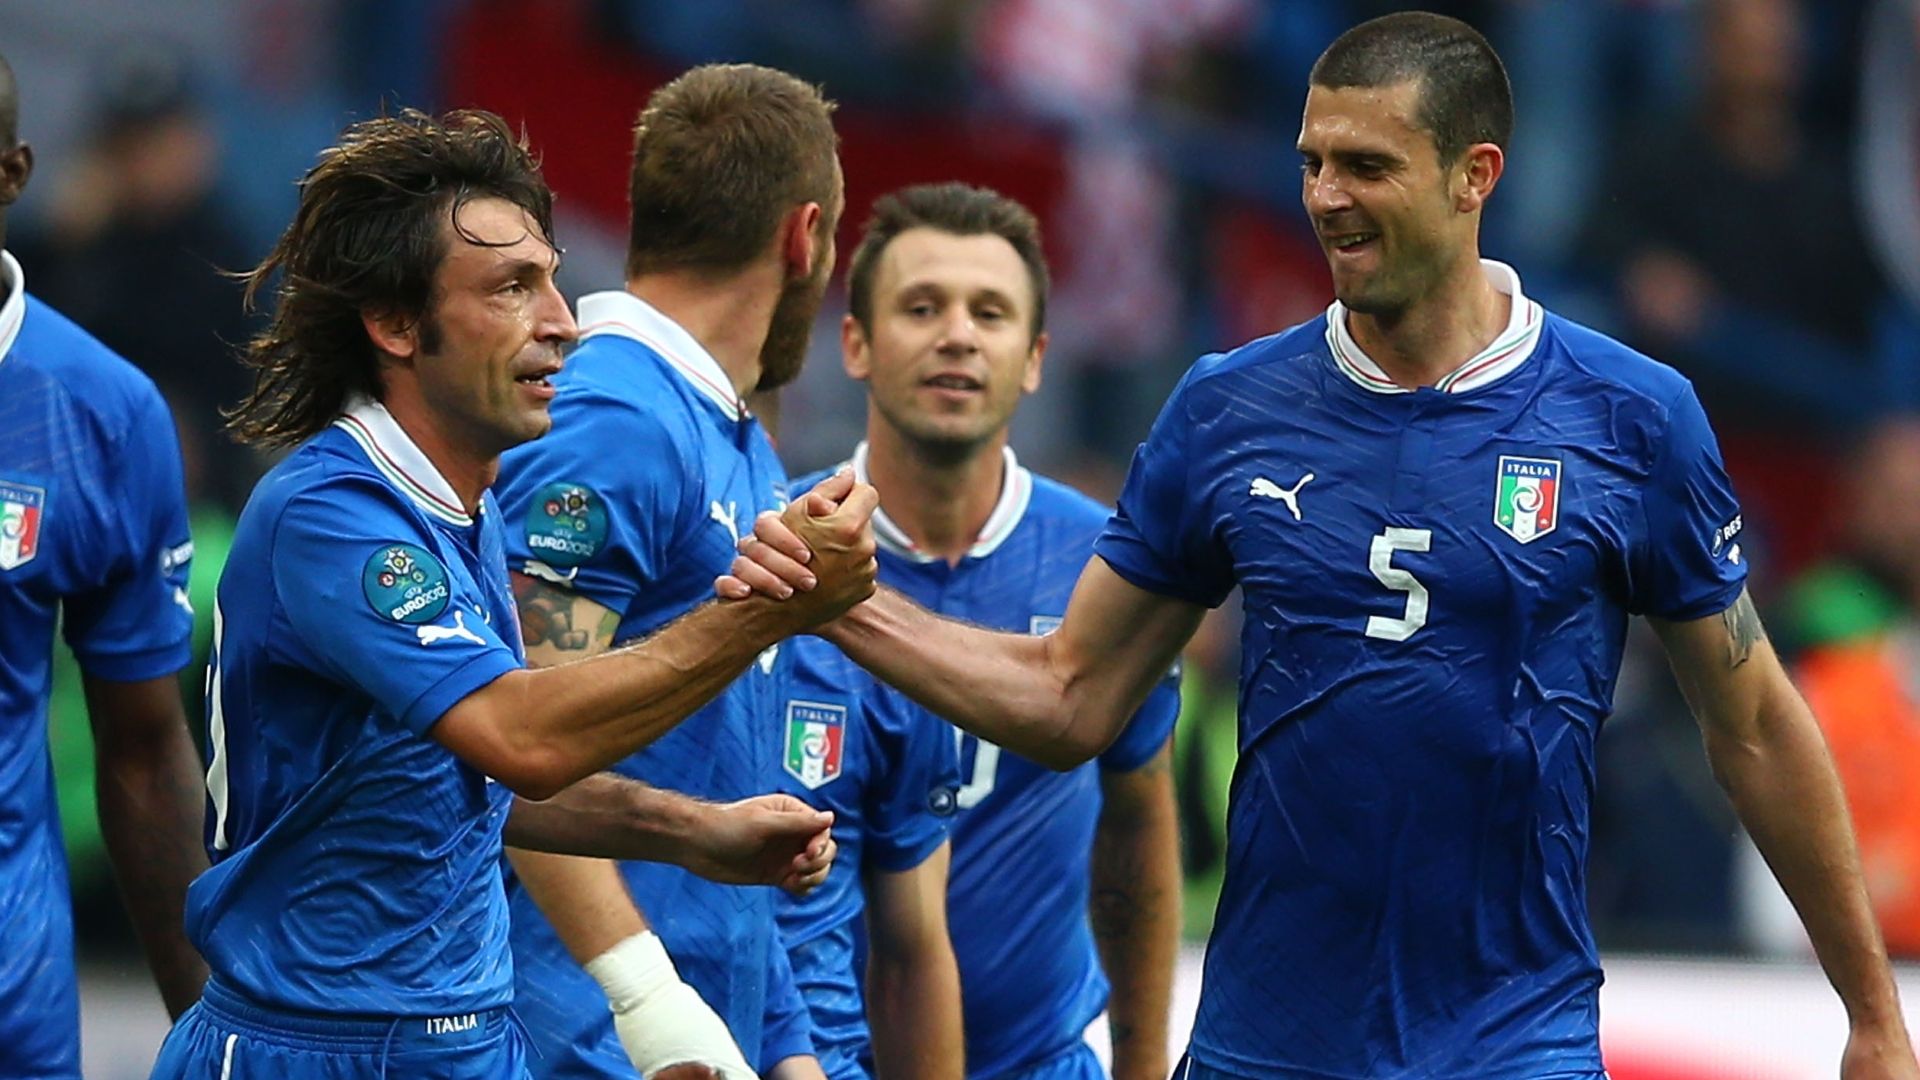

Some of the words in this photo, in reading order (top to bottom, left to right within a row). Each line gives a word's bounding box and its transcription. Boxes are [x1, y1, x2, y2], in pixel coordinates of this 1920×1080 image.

[1507, 463, 1551, 476] ITALIA
[1365, 526, 1432, 642] 5
[796, 708, 837, 722] ITALIA
[427, 1013, 478, 1034] ITALIA
